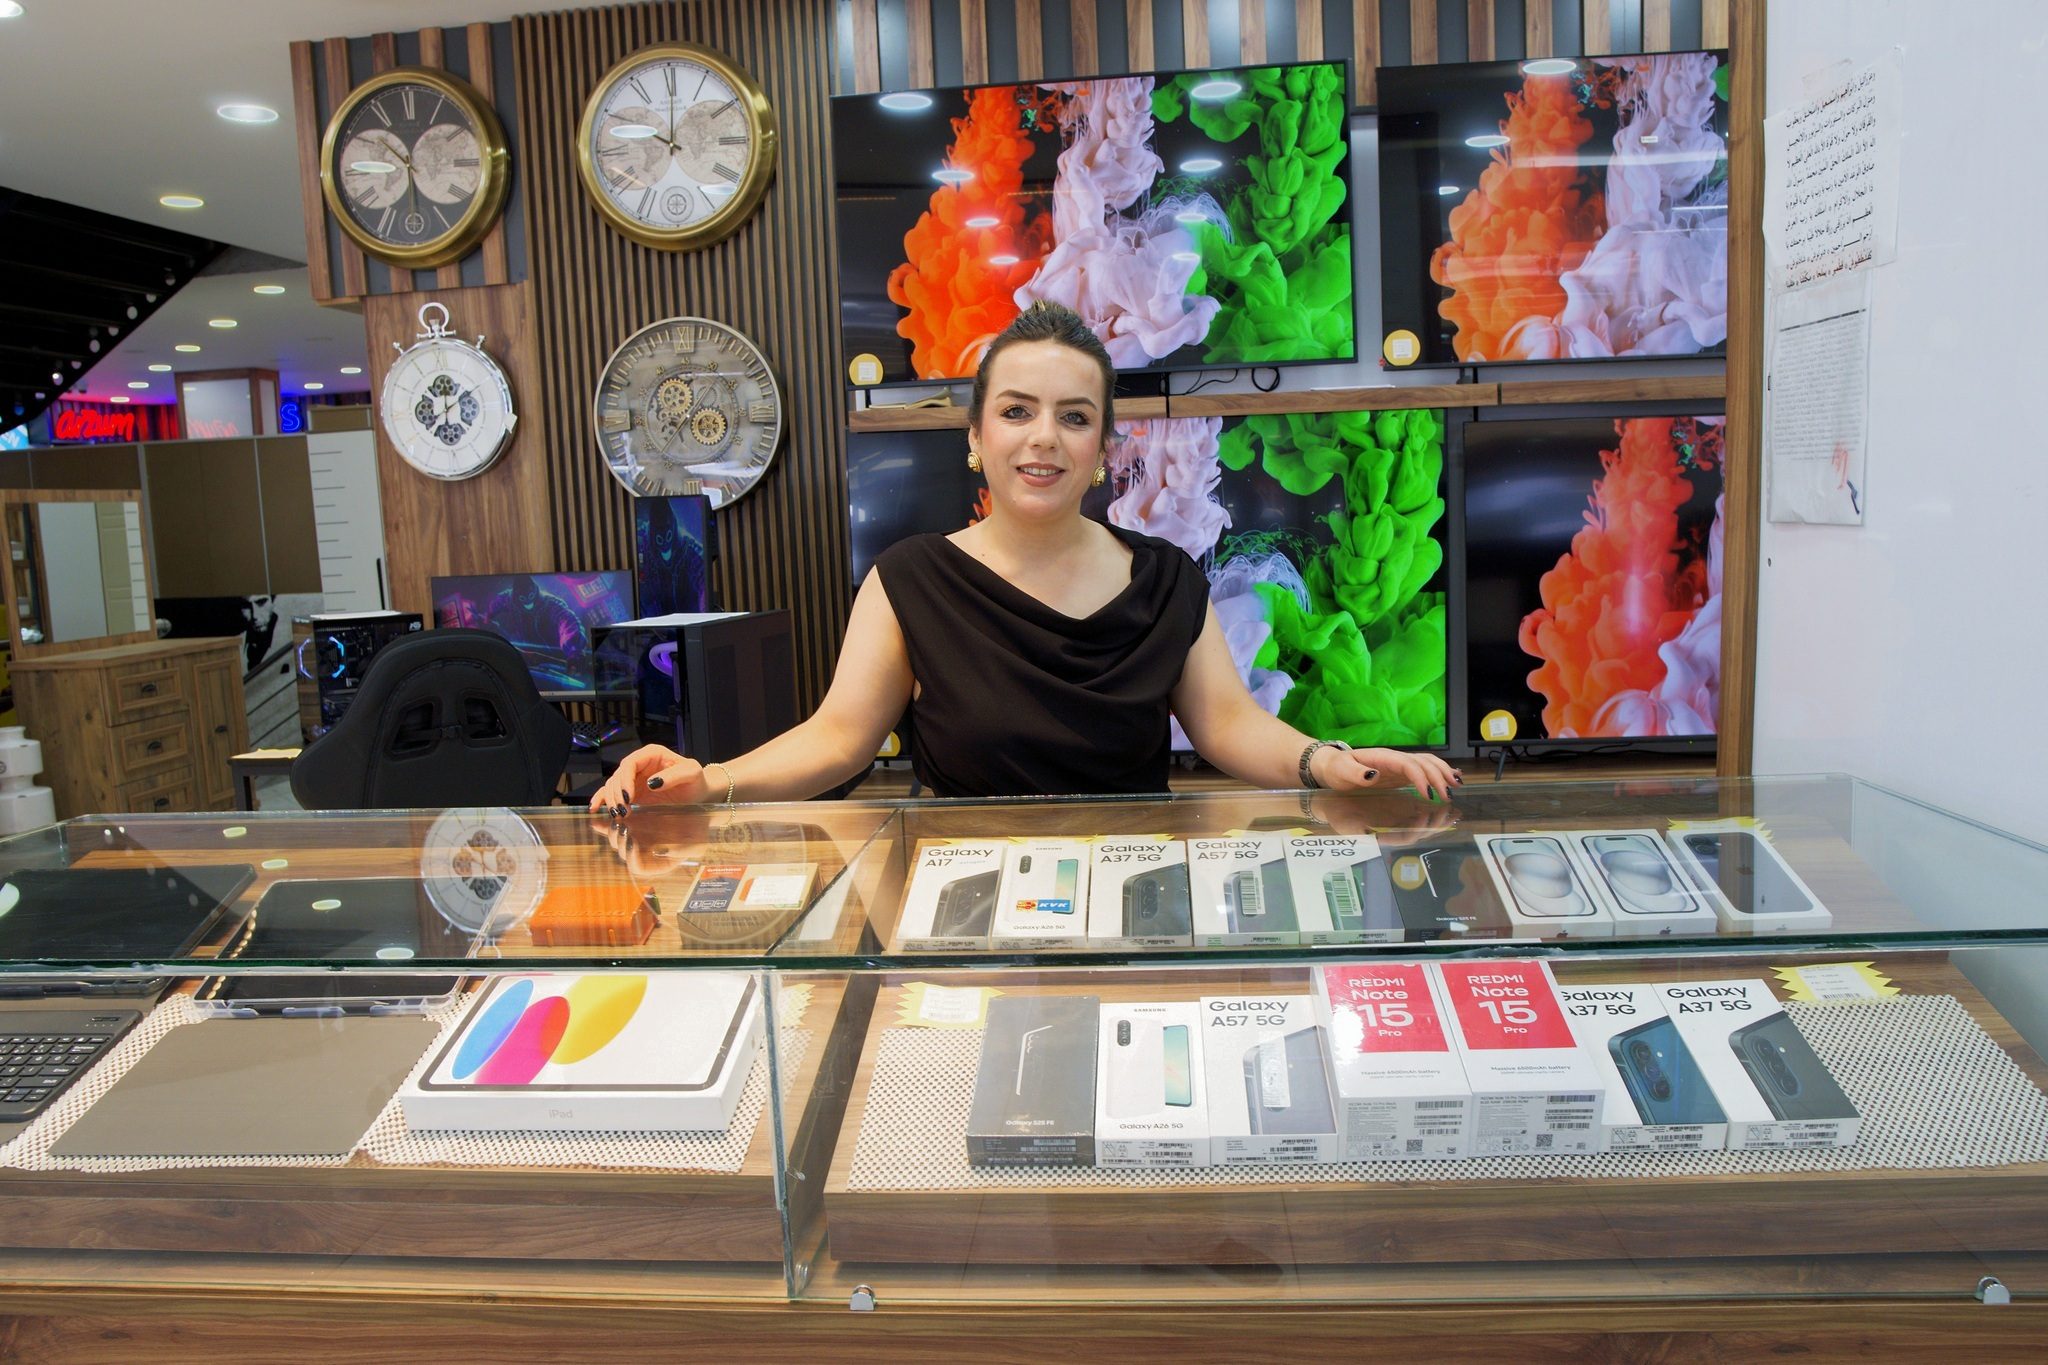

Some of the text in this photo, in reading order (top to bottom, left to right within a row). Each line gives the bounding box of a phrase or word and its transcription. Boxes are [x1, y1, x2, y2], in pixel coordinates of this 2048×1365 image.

[1195, 839, 1263, 852] Galaxy
[1290, 836, 1357, 849] Galaxy
[928, 848, 994, 857] Galaxy
[1100, 842, 1168, 855] Galaxy
[1197, 848, 1259, 860] A57 5G
[1292, 846, 1356, 858] A57 5G
[925, 859, 952, 867] A17
[1100, 851, 1161, 864] A37 5G
[1349, 978, 1405, 988] REDMI
[1467, 974, 1524, 984] REDMI
[1351, 989, 1408, 1000] Note
[1471, 986, 1529, 997] Note
[1667, 987, 1746, 998] Galaxy
[1209, 1001, 1289, 1013] Galaxy
[1478, 1000, 1537, 1024] 15
[1605, 1004, 1636, 1015] 5G
[1679, 1000, 1752, 1014] A37 5G
[1356, 1003, 1414, 1027] 15
[1211, 1015, 1286, 1027] A57 5G
[1378, 1029, 1402, 1037] Pro
[1503, 1026, 1528, 1034] Pro
[549, 1109, 573, 1119] iPad
[1119, 1123, 1152, 1131] Galaxy
